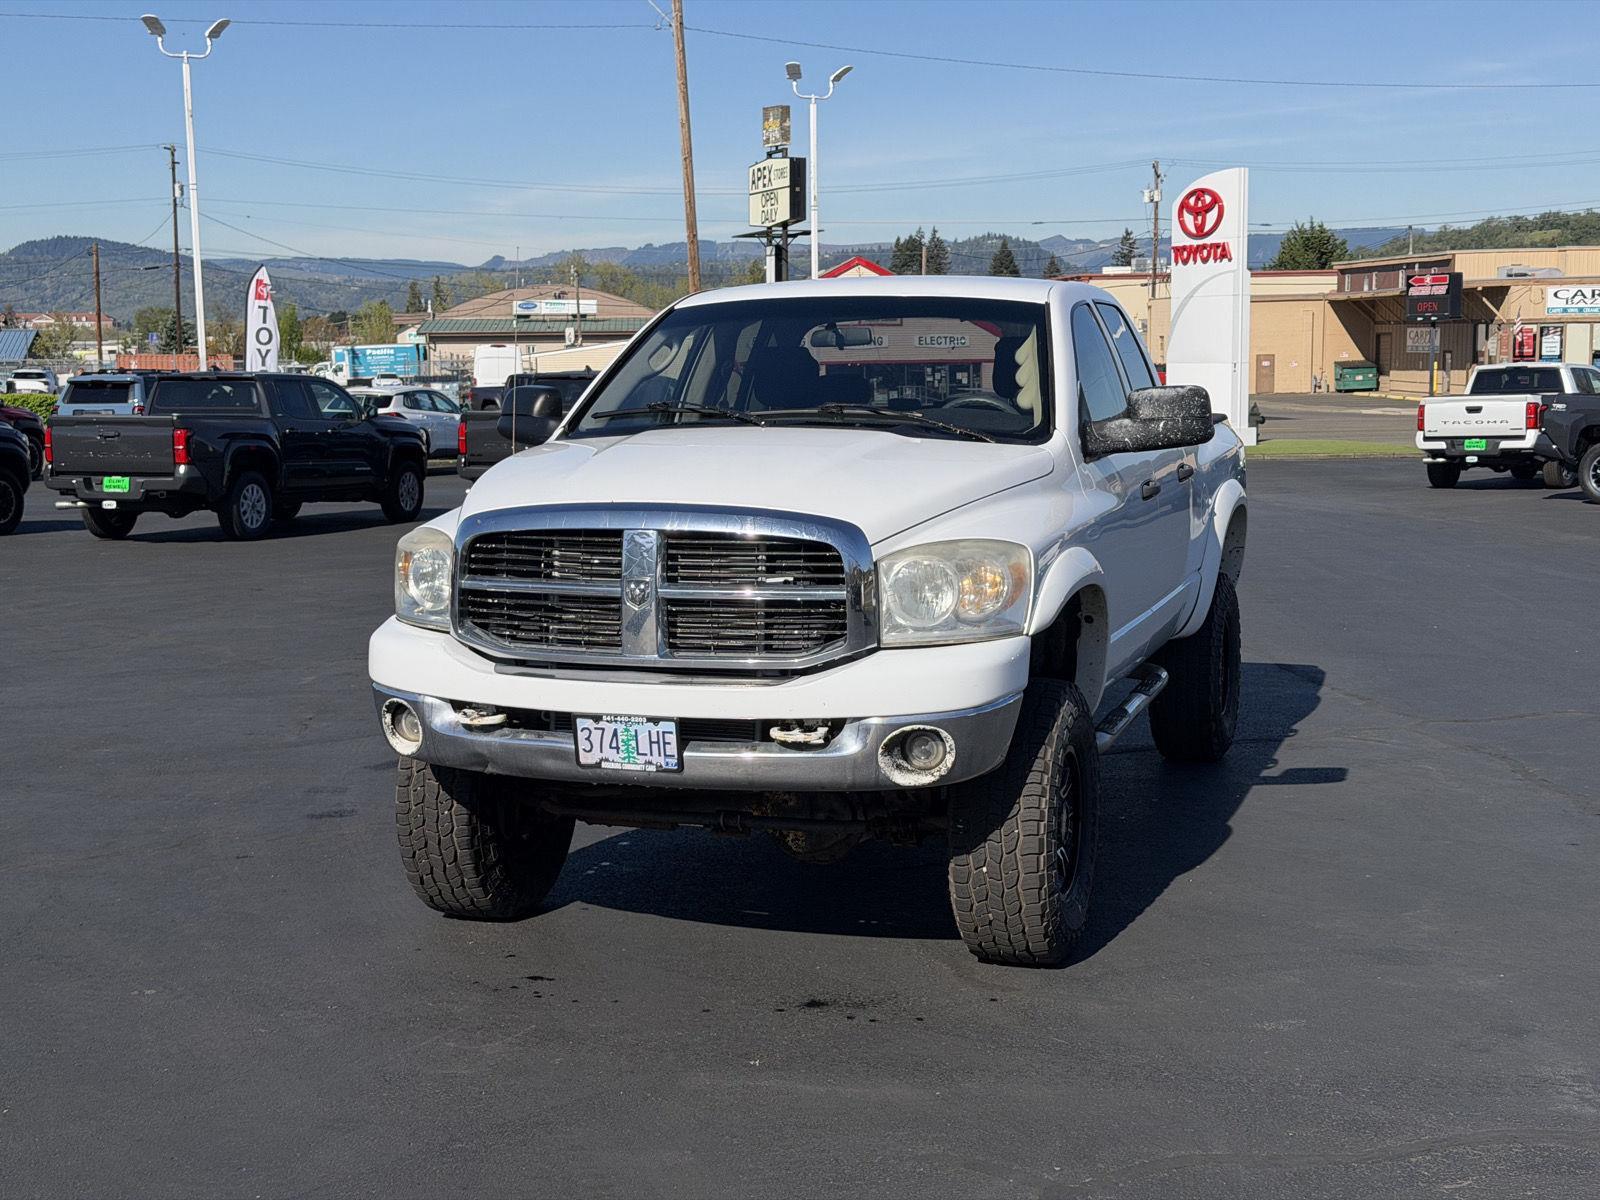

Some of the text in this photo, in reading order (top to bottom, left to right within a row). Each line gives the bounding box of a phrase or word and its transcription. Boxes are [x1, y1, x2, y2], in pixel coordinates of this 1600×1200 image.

[751, 165, 772, 190] APEX
[761, 192, 778, 208] OPEN
[761, 208, 778, 224] DAILY
[1172, 242, 1232, 266] TOYOTA
[1417, 302, 1438, 312] OPEN
[255, 305, 273, 372] TOY
[918, 335, 967, 346] ELECTRIC
[1409, 330, 1438, 340] CARPT
[580, 726, 676, 758] 374 LHE
